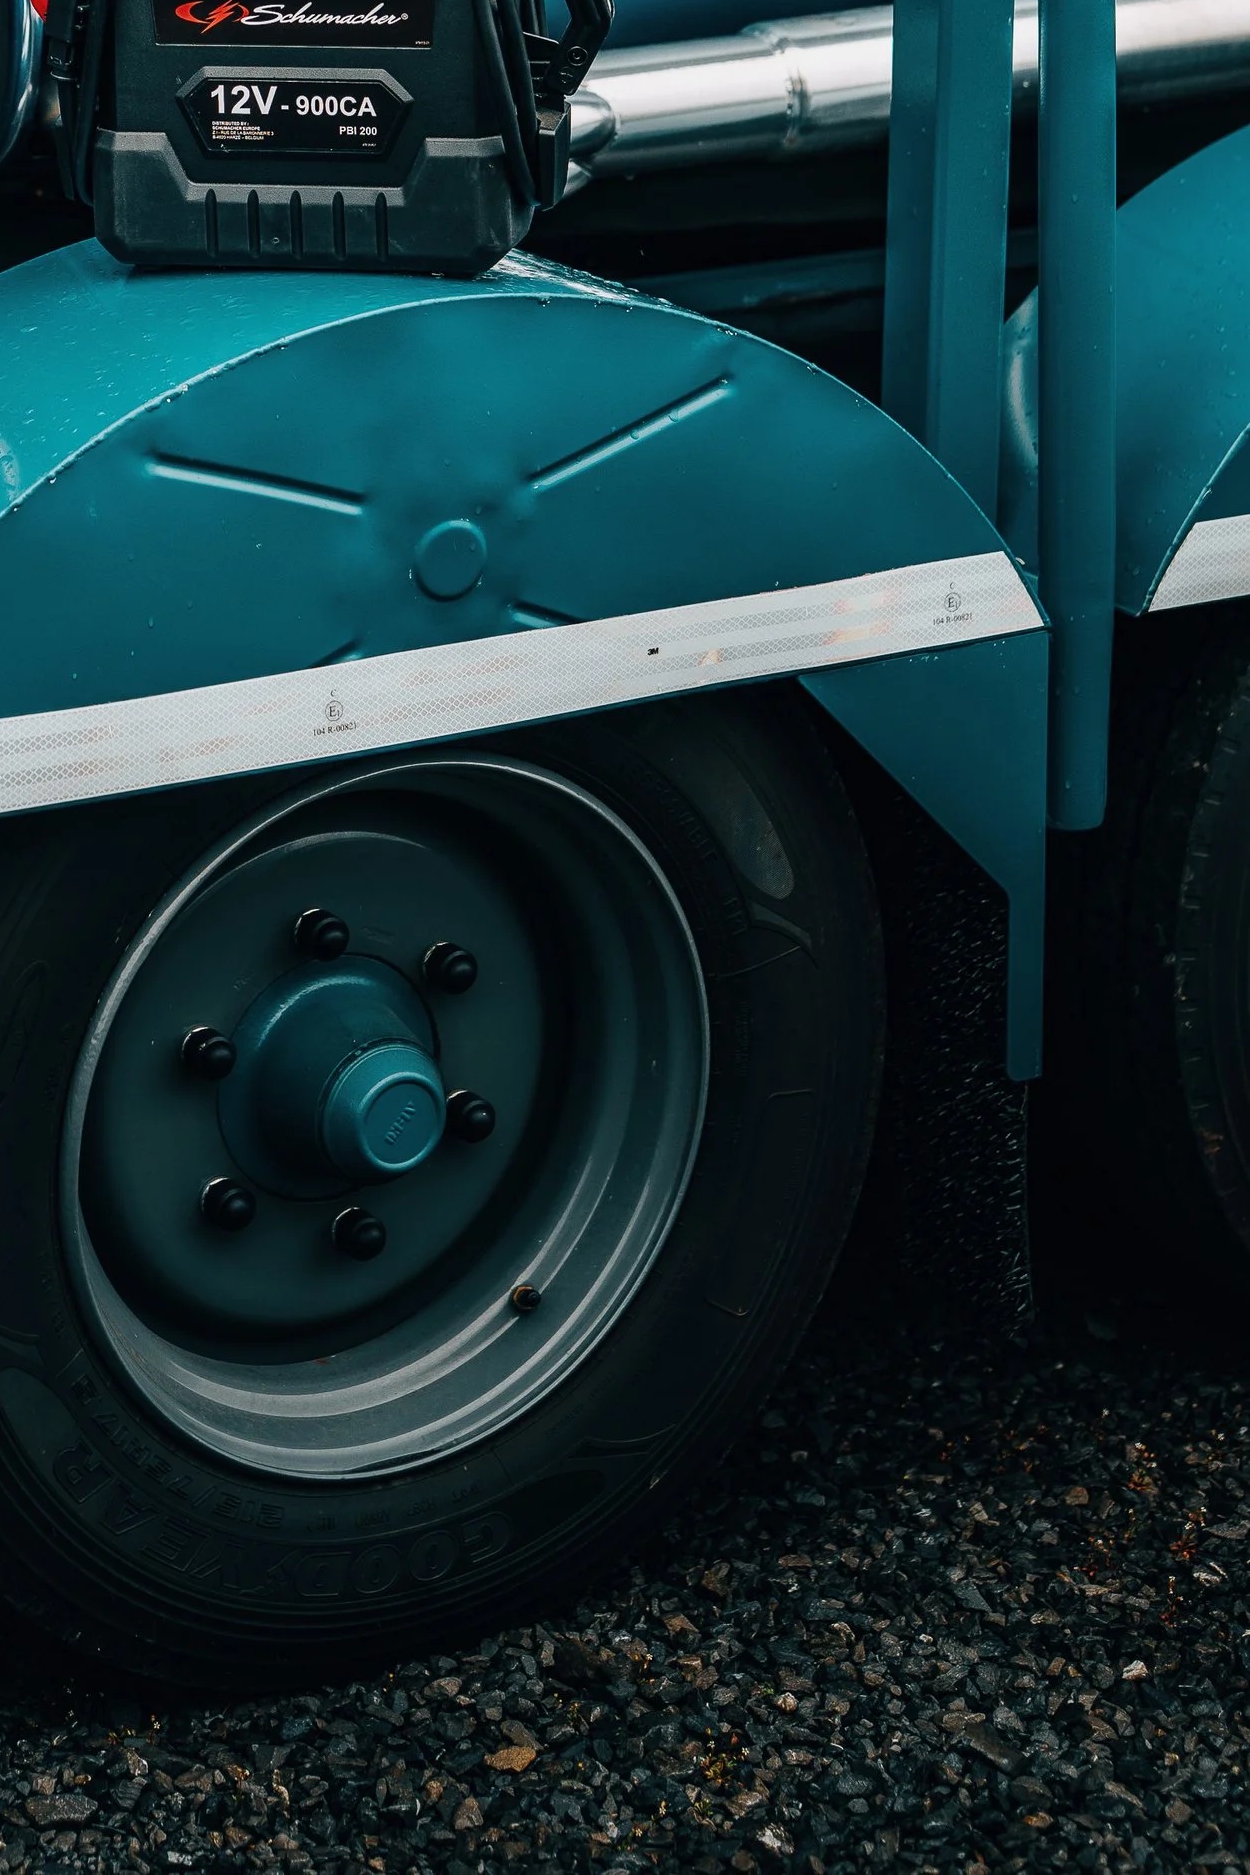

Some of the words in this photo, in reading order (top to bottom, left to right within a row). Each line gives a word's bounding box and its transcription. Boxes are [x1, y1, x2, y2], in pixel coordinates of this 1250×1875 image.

[210, 84, 278, 115] 12V
[295, 95, 377, 117] 900CA
[339, 126, 357, 136] PBI
[359, 126, 378, 136] 200
[648, 647, 659, 655] 3M
[52, 1437, 512, 1597] GOODYEAR
